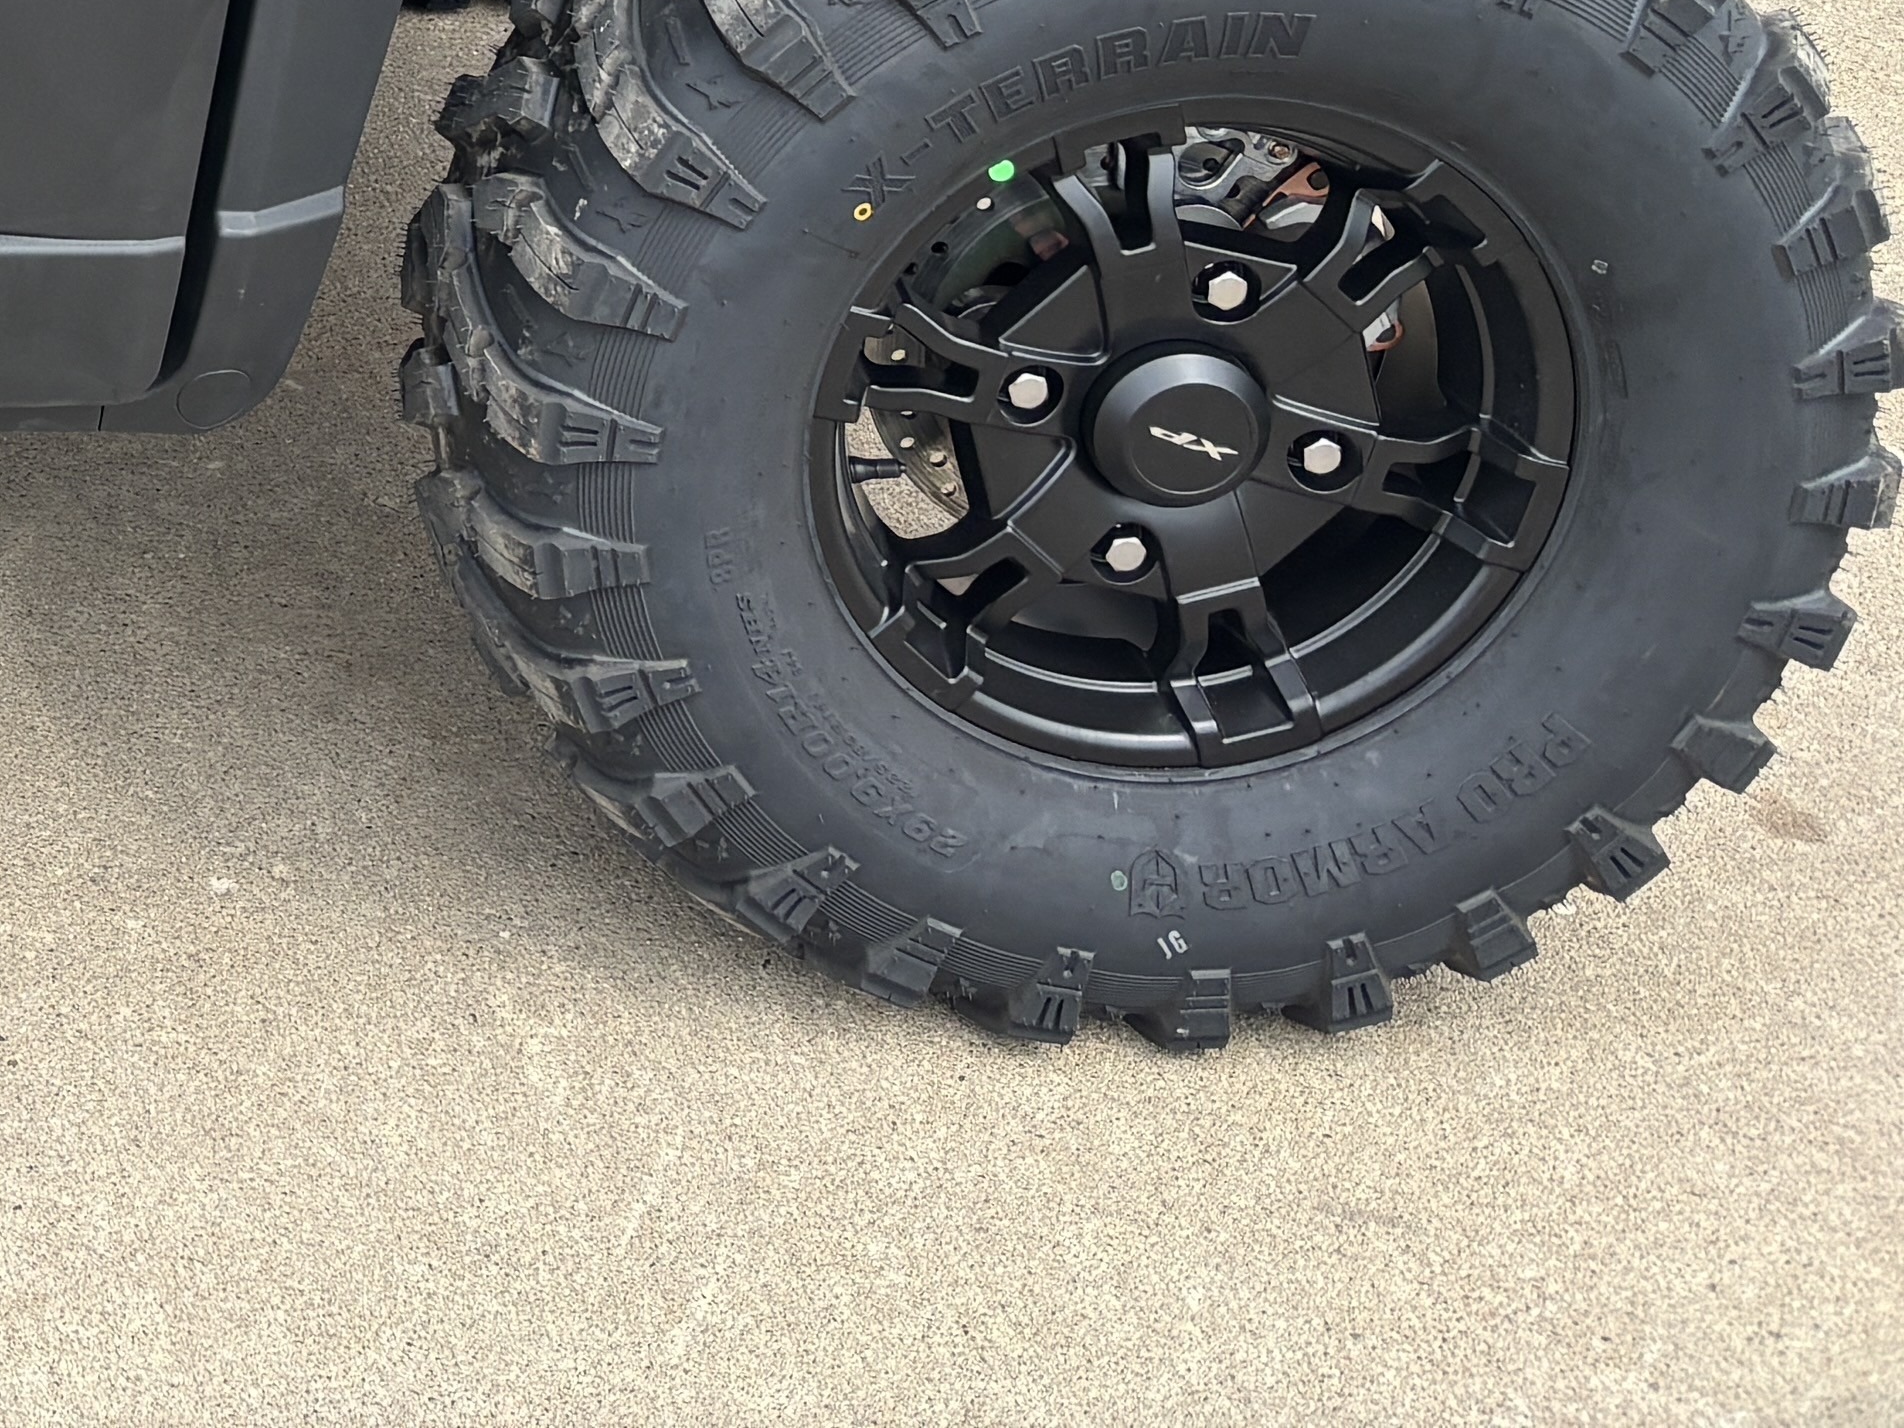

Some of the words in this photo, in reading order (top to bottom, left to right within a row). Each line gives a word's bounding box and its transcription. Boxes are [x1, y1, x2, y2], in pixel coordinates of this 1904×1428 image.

[842, 12, 1317, 208] X-TERRAIN
[1148, 426, 1239, 461] XP
[1456, 712, 1592, 824] PRO
[1198, 799, 1438, 912] ARMOR
